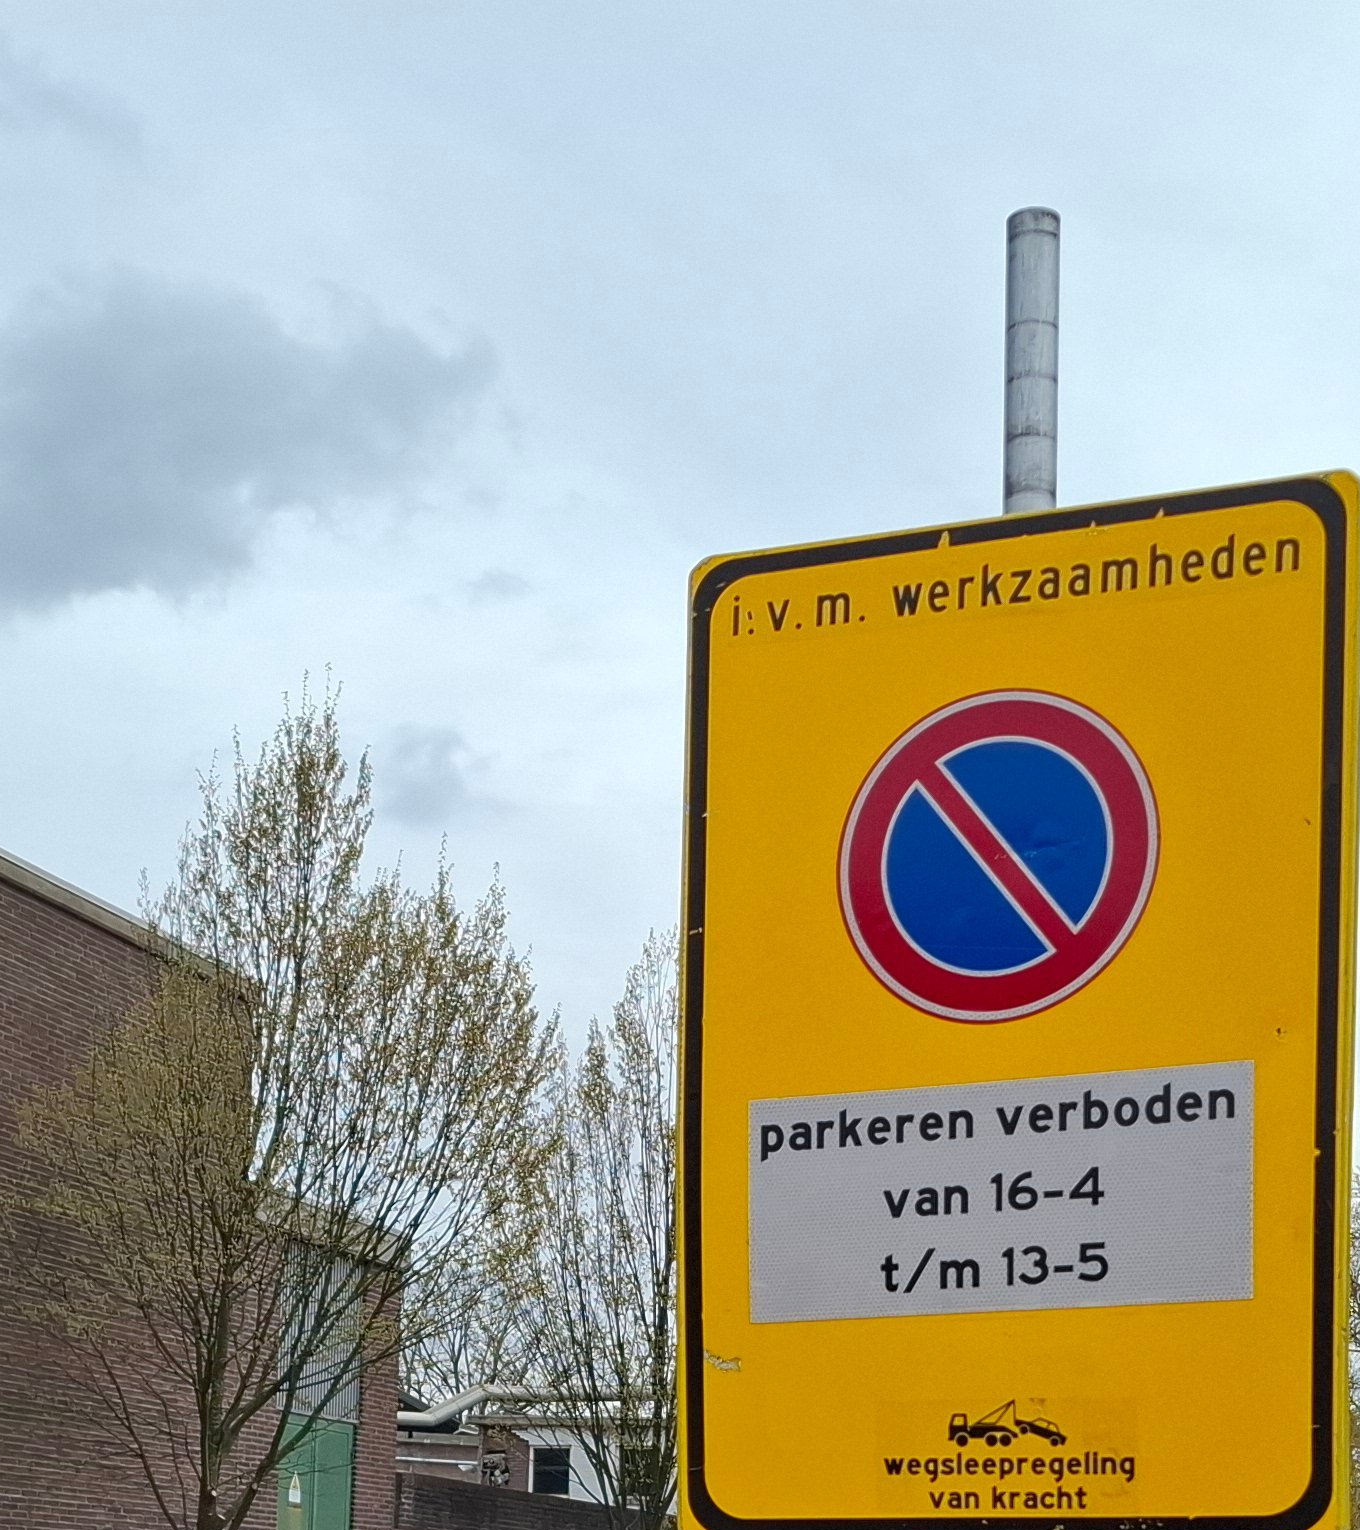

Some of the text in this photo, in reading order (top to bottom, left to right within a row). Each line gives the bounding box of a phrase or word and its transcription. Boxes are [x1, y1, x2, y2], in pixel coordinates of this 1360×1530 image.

[732, 533, 1301, 637] i.v.m. werkzaamheden
[760, 1082, 1236, 1162] parkeren verboden
[883, 1166, 1105, 1218] van 16-4
[880, 1242, 1109, 1294] t/m 13-5
[883, 1451, 1135, 1483] wegsleepregeling
[929, 1485, 1088, 1510] van kracht
